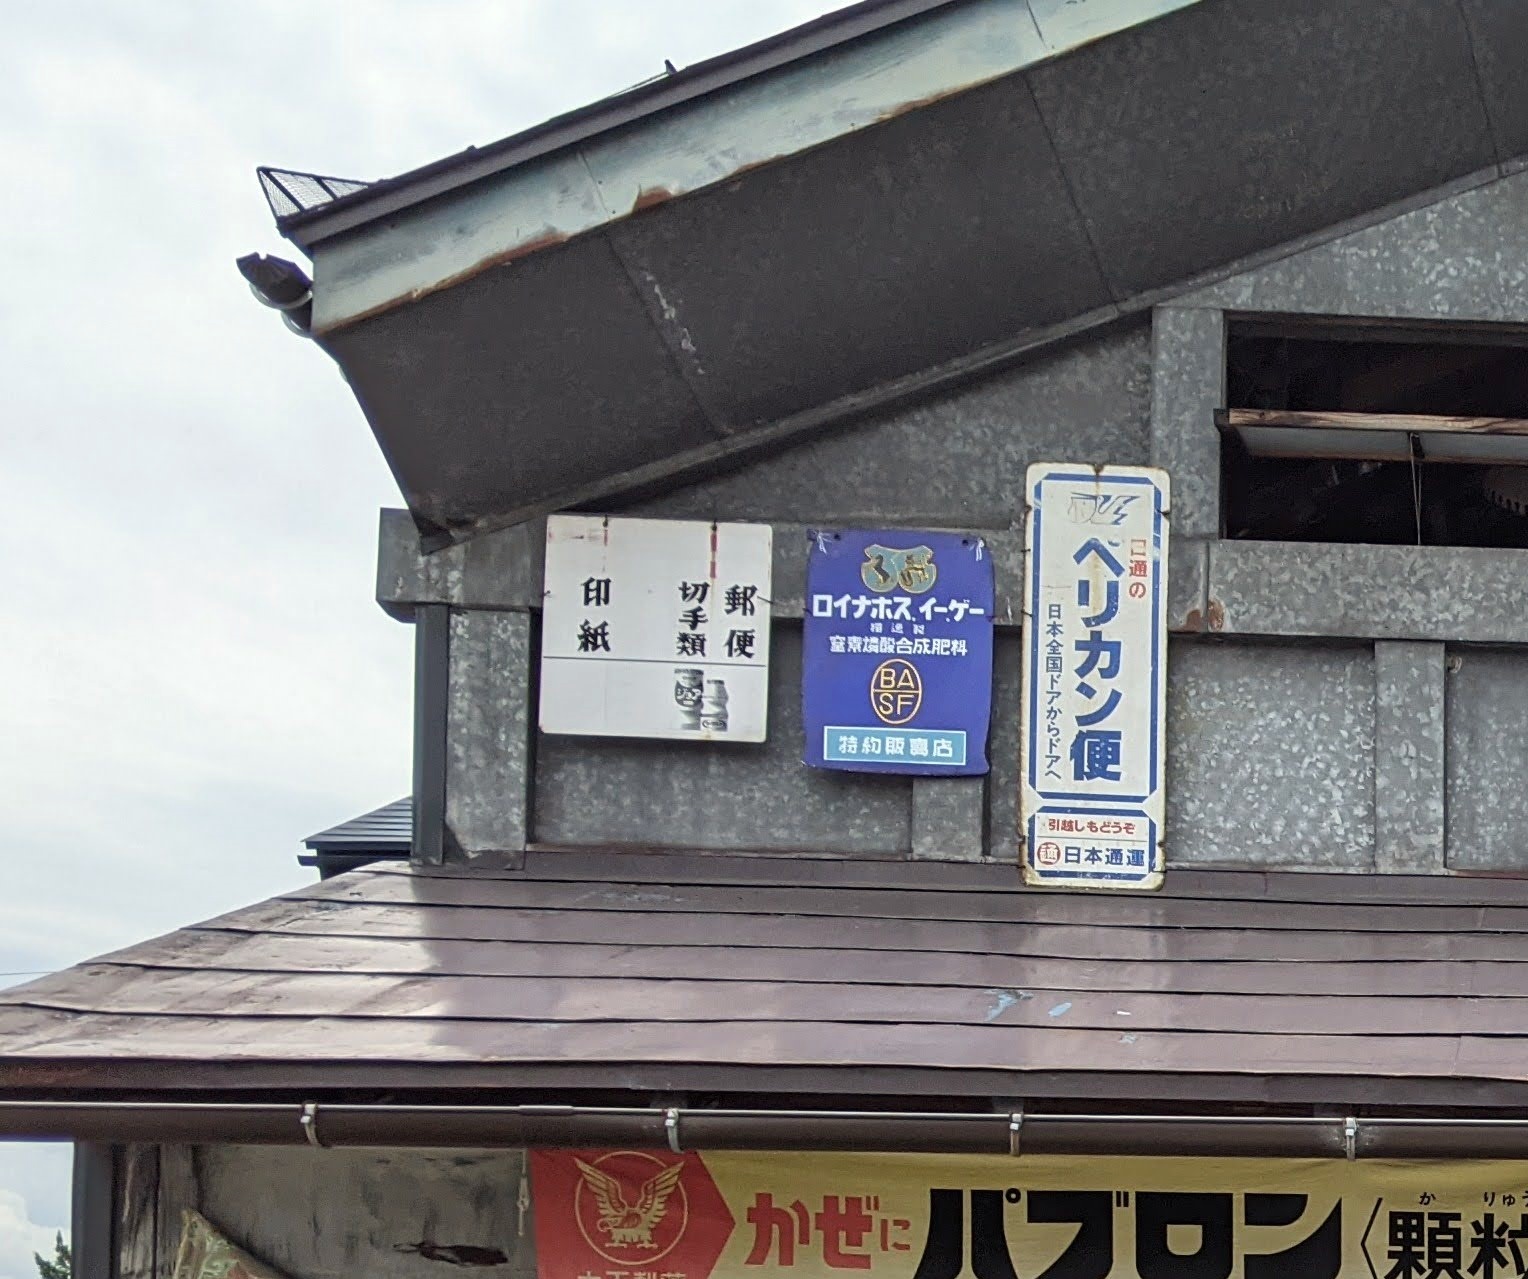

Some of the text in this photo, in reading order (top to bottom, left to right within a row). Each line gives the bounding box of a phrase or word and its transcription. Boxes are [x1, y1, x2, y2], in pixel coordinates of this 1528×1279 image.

[577, 576, 612, 652] 印紙
[676, 581, 711, 658] 切手類
[724, 584, 758, 659] 郵便
[1044, 603, 1064, 780] 日本全国ドアからドアへ
[1069, 537, 1126, 782] ペリカン便
[1048, 818, 1136, 835] 引越しもどうぞ
[1064, 845, 1146, 867] 日本通運
[744, 1192, 911, 1270] かぜに
